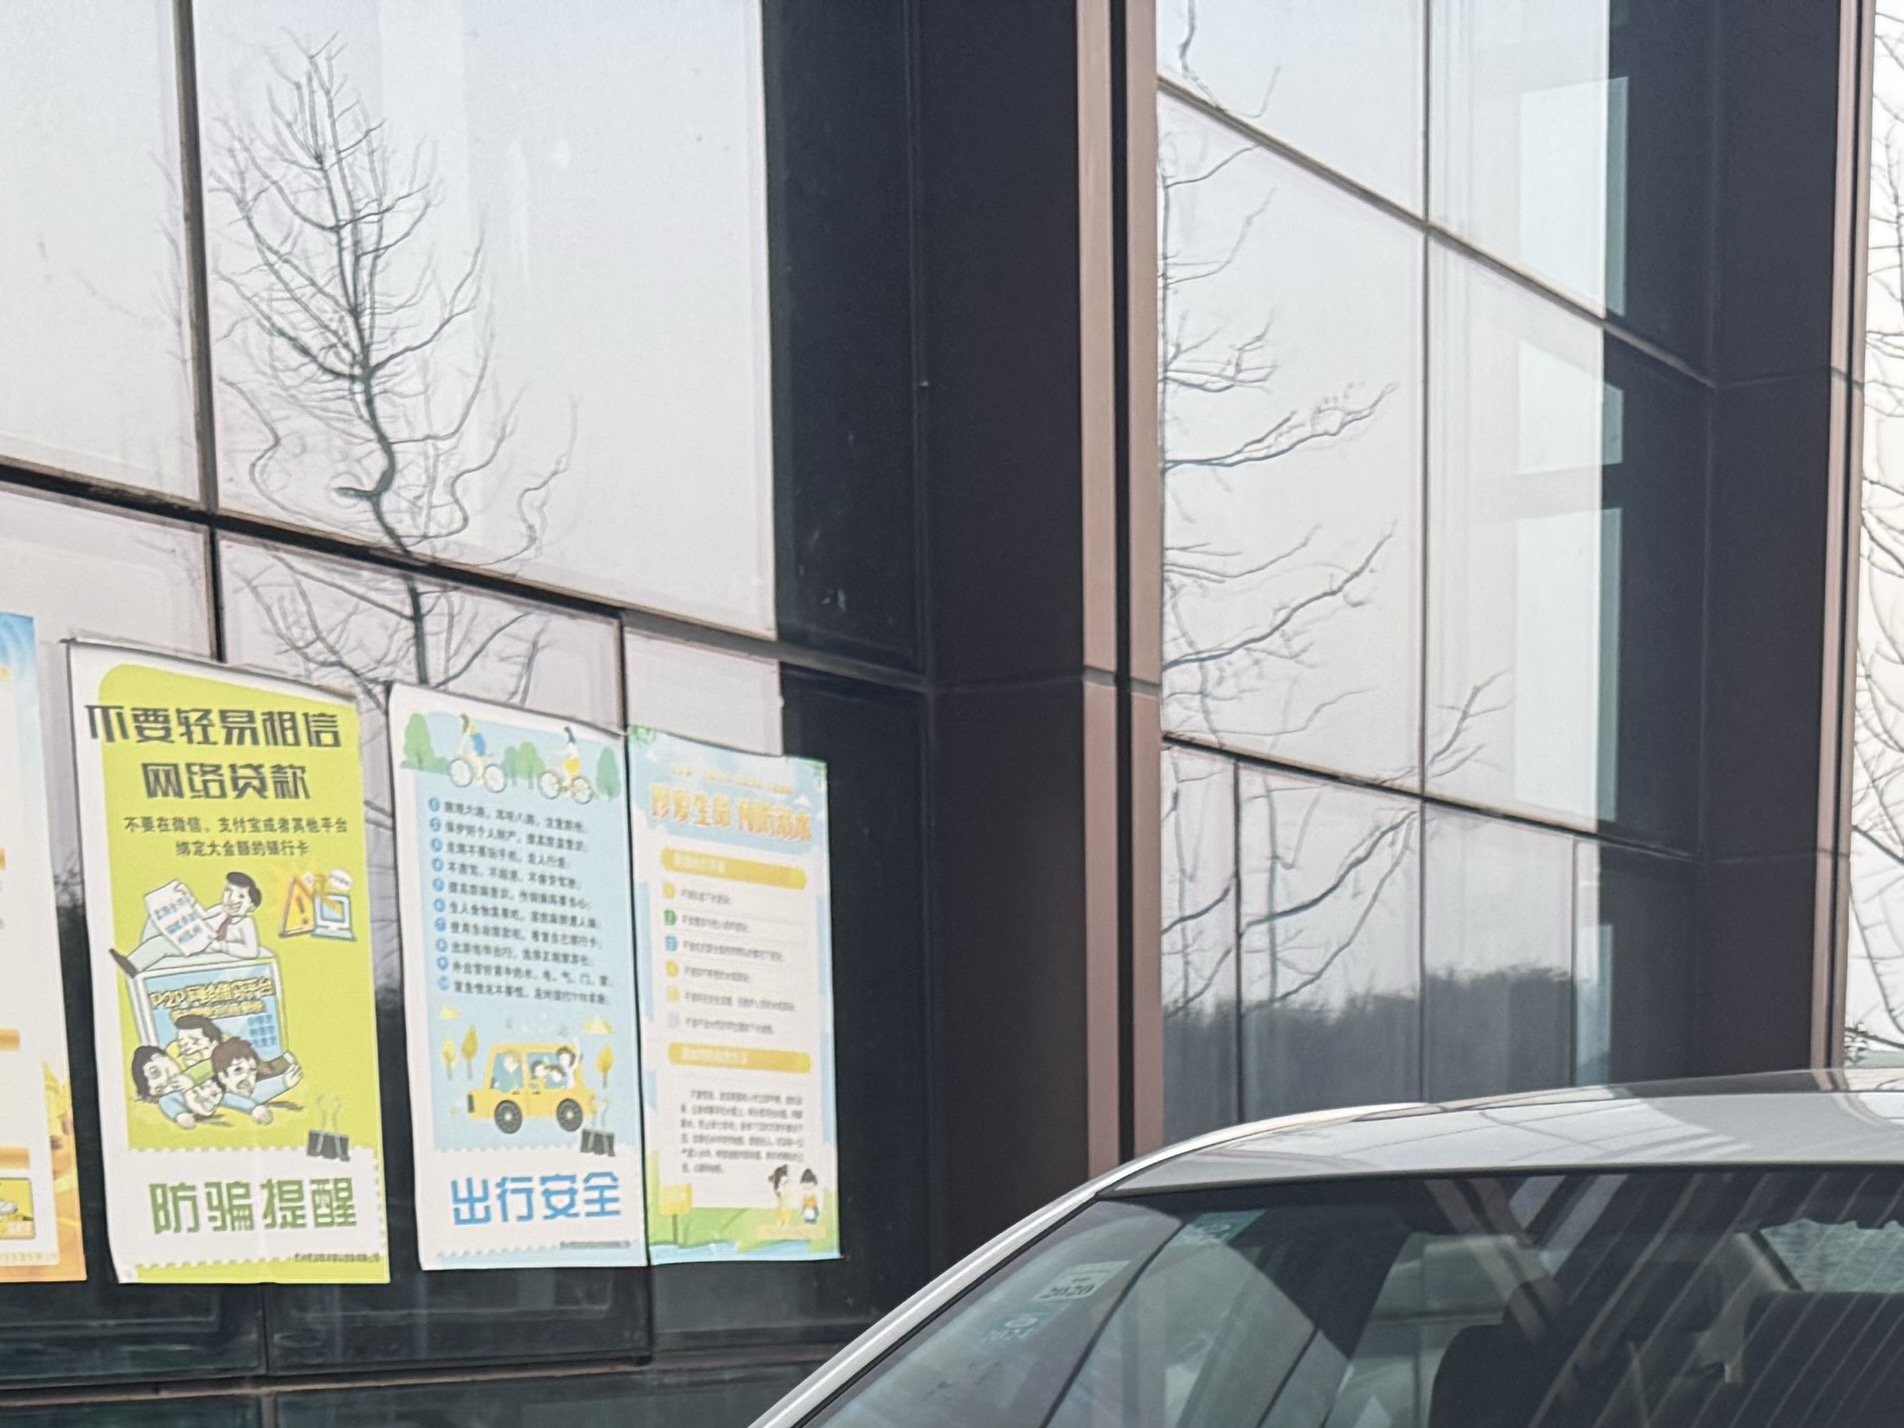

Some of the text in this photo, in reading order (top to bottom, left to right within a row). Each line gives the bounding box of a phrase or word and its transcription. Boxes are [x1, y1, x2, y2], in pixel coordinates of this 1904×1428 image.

[86, 705, 341, 747] 不要轻易相信
[142, 762, 311, 799] 网络贷款
[149, 1177, 356, 1235] 防骗提醒
[451, 1170, 621, 1226] 出行安全
